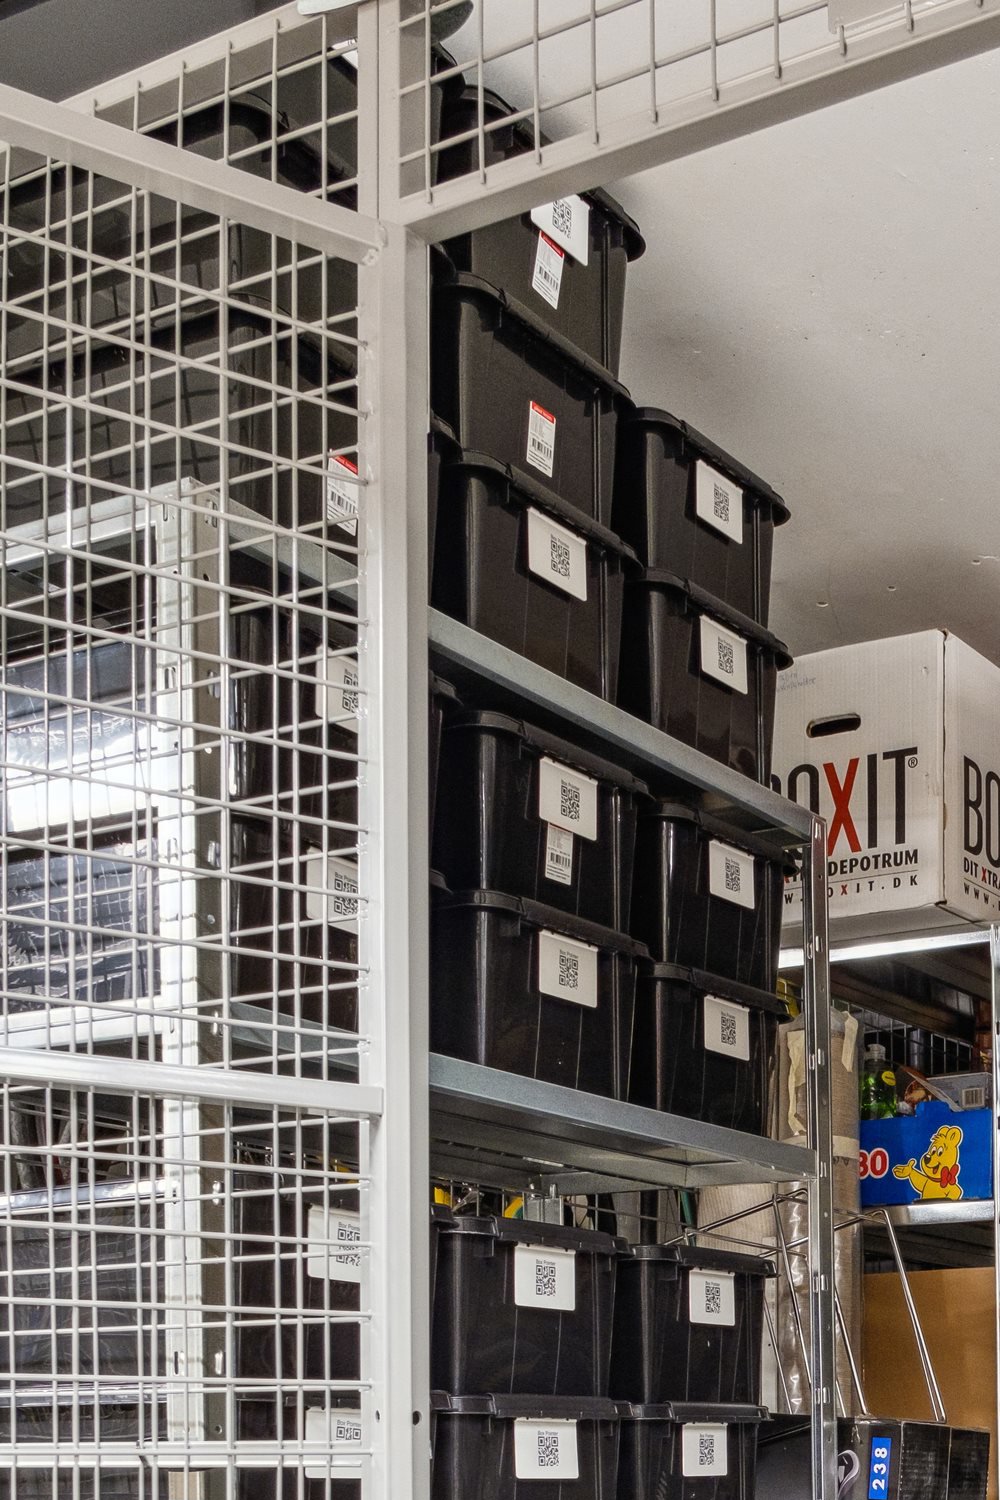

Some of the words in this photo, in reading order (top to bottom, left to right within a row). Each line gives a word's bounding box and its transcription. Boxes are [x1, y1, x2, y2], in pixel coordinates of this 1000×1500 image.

[771, 746, 918, 861] OXIT
[828, 848, 919, 877] DEPOTRUM
[964, 857, 979, 878] DIT
[872, 1447, 888, 1490] 238
